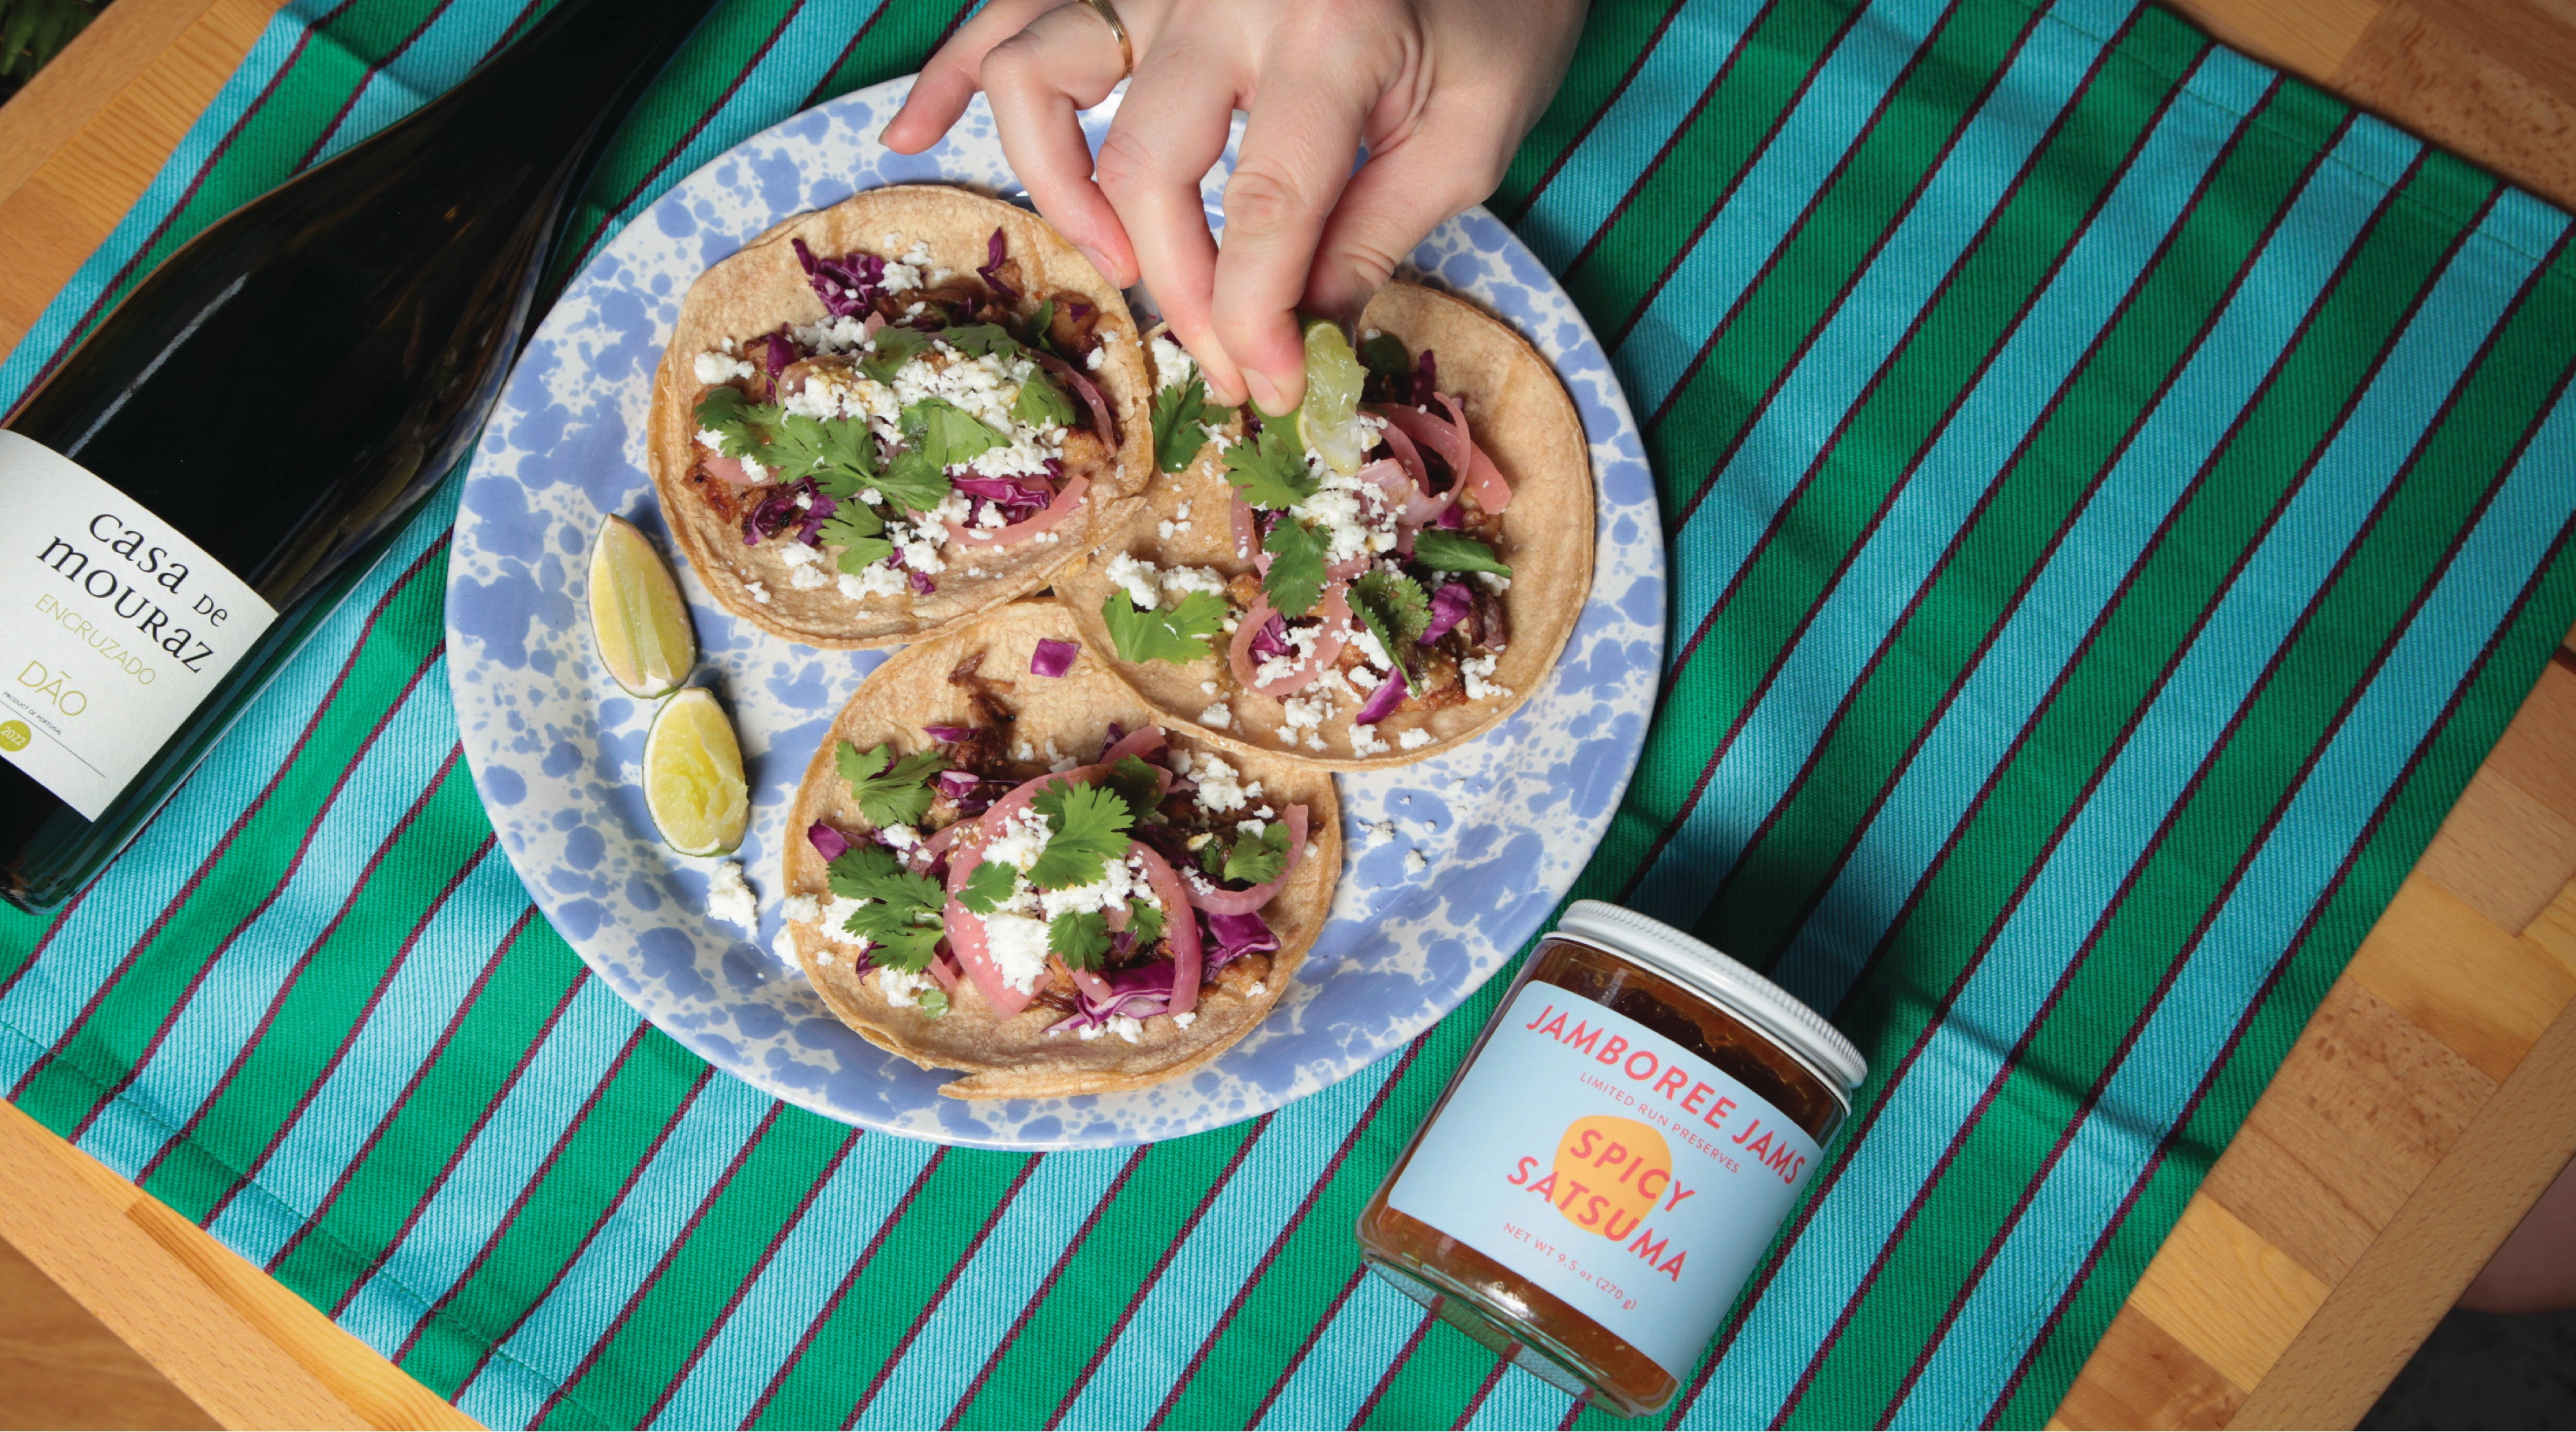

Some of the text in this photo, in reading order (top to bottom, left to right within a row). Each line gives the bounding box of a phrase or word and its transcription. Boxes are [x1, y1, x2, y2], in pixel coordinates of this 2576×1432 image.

[35, 593, 157, 685] ENCRUZADO
[1, 726, 26, 746] 2022
[3, 691, 30, 711] PRODUCT
[36, 715, 63, 736] PORTUGAL
[1526, 1005, 1806, 1185] JAMBOREE JAMS
[1579, 1072, 1741, 1174] LIMITED RUN PRESERVES
[1570, 1129, 1696, 1212] SPICY
[1506, 1156, 1687, 1283] SATSUMA
[1502, 1222, 1638, 1310] NET WT 9.5 oz (270 g)
